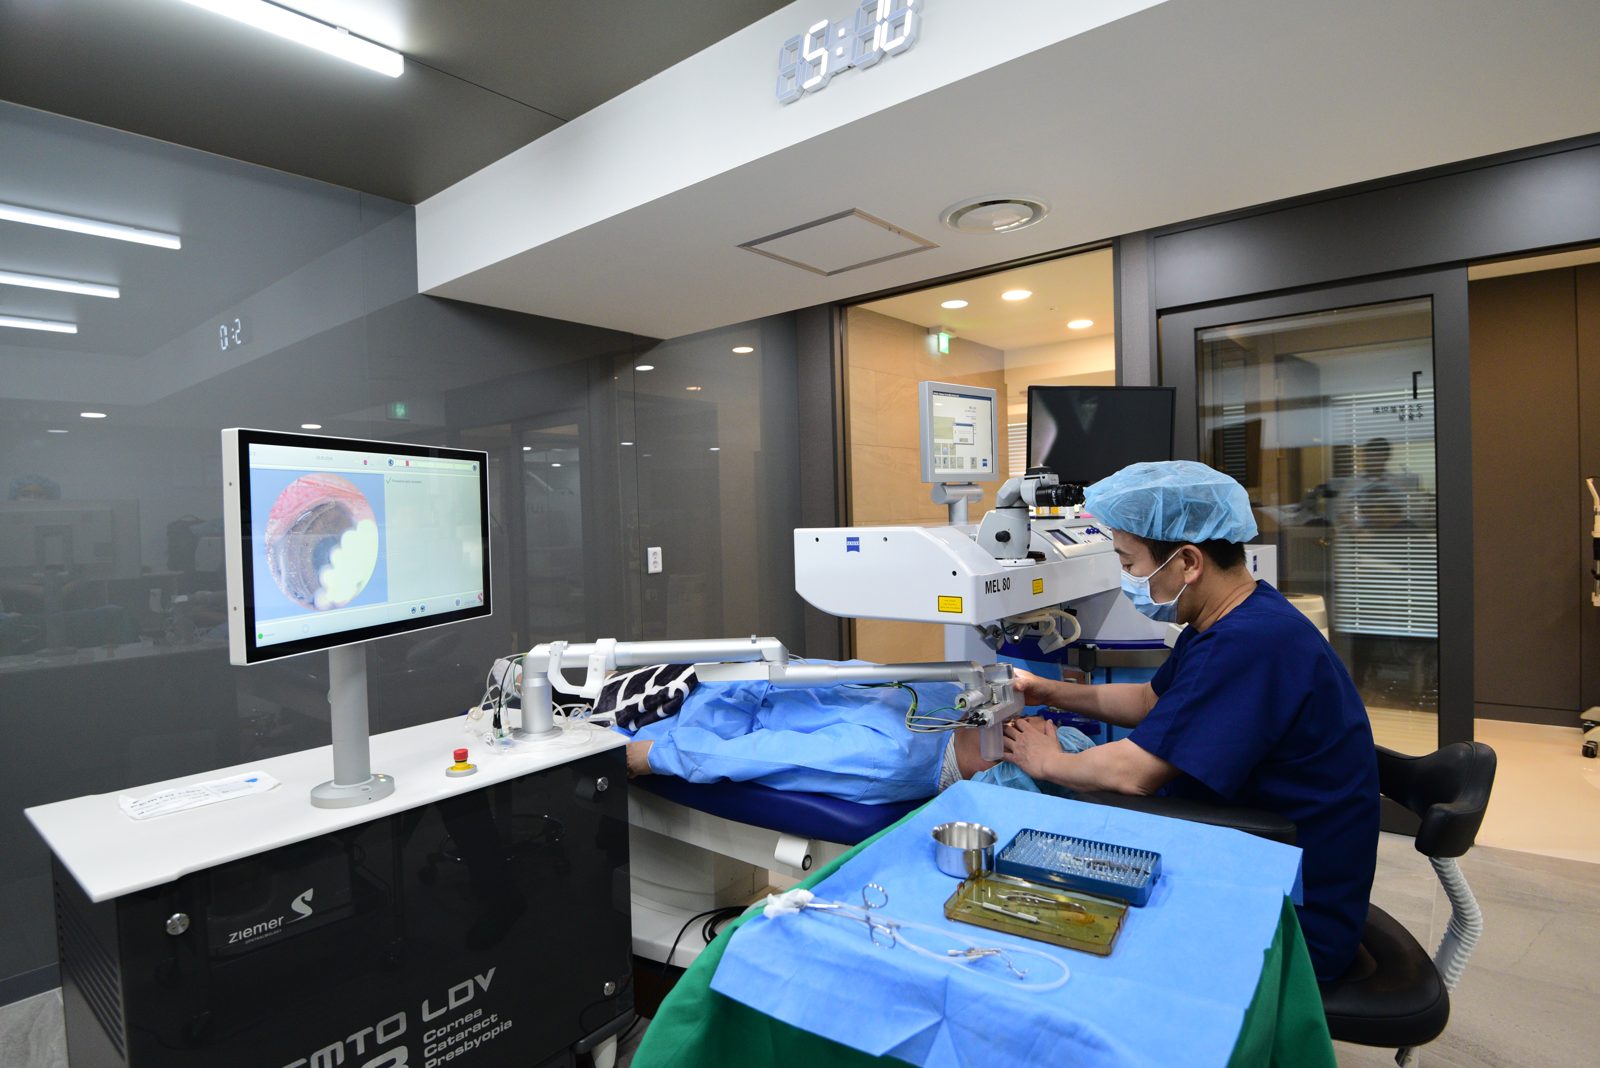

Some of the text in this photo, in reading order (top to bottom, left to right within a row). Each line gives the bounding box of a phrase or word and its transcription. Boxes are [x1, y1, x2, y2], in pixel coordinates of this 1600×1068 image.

[985, 577, 1011, 594] MEL 80
[228, 916, 285, 943] ziemer
[421, 967, 496, 1022] LDV
[423, 1008, 483, 1044] Cornea
[423, 1013, 498, 1058] Cataract
[424, 1019, 512, 1068] Presbyopia
